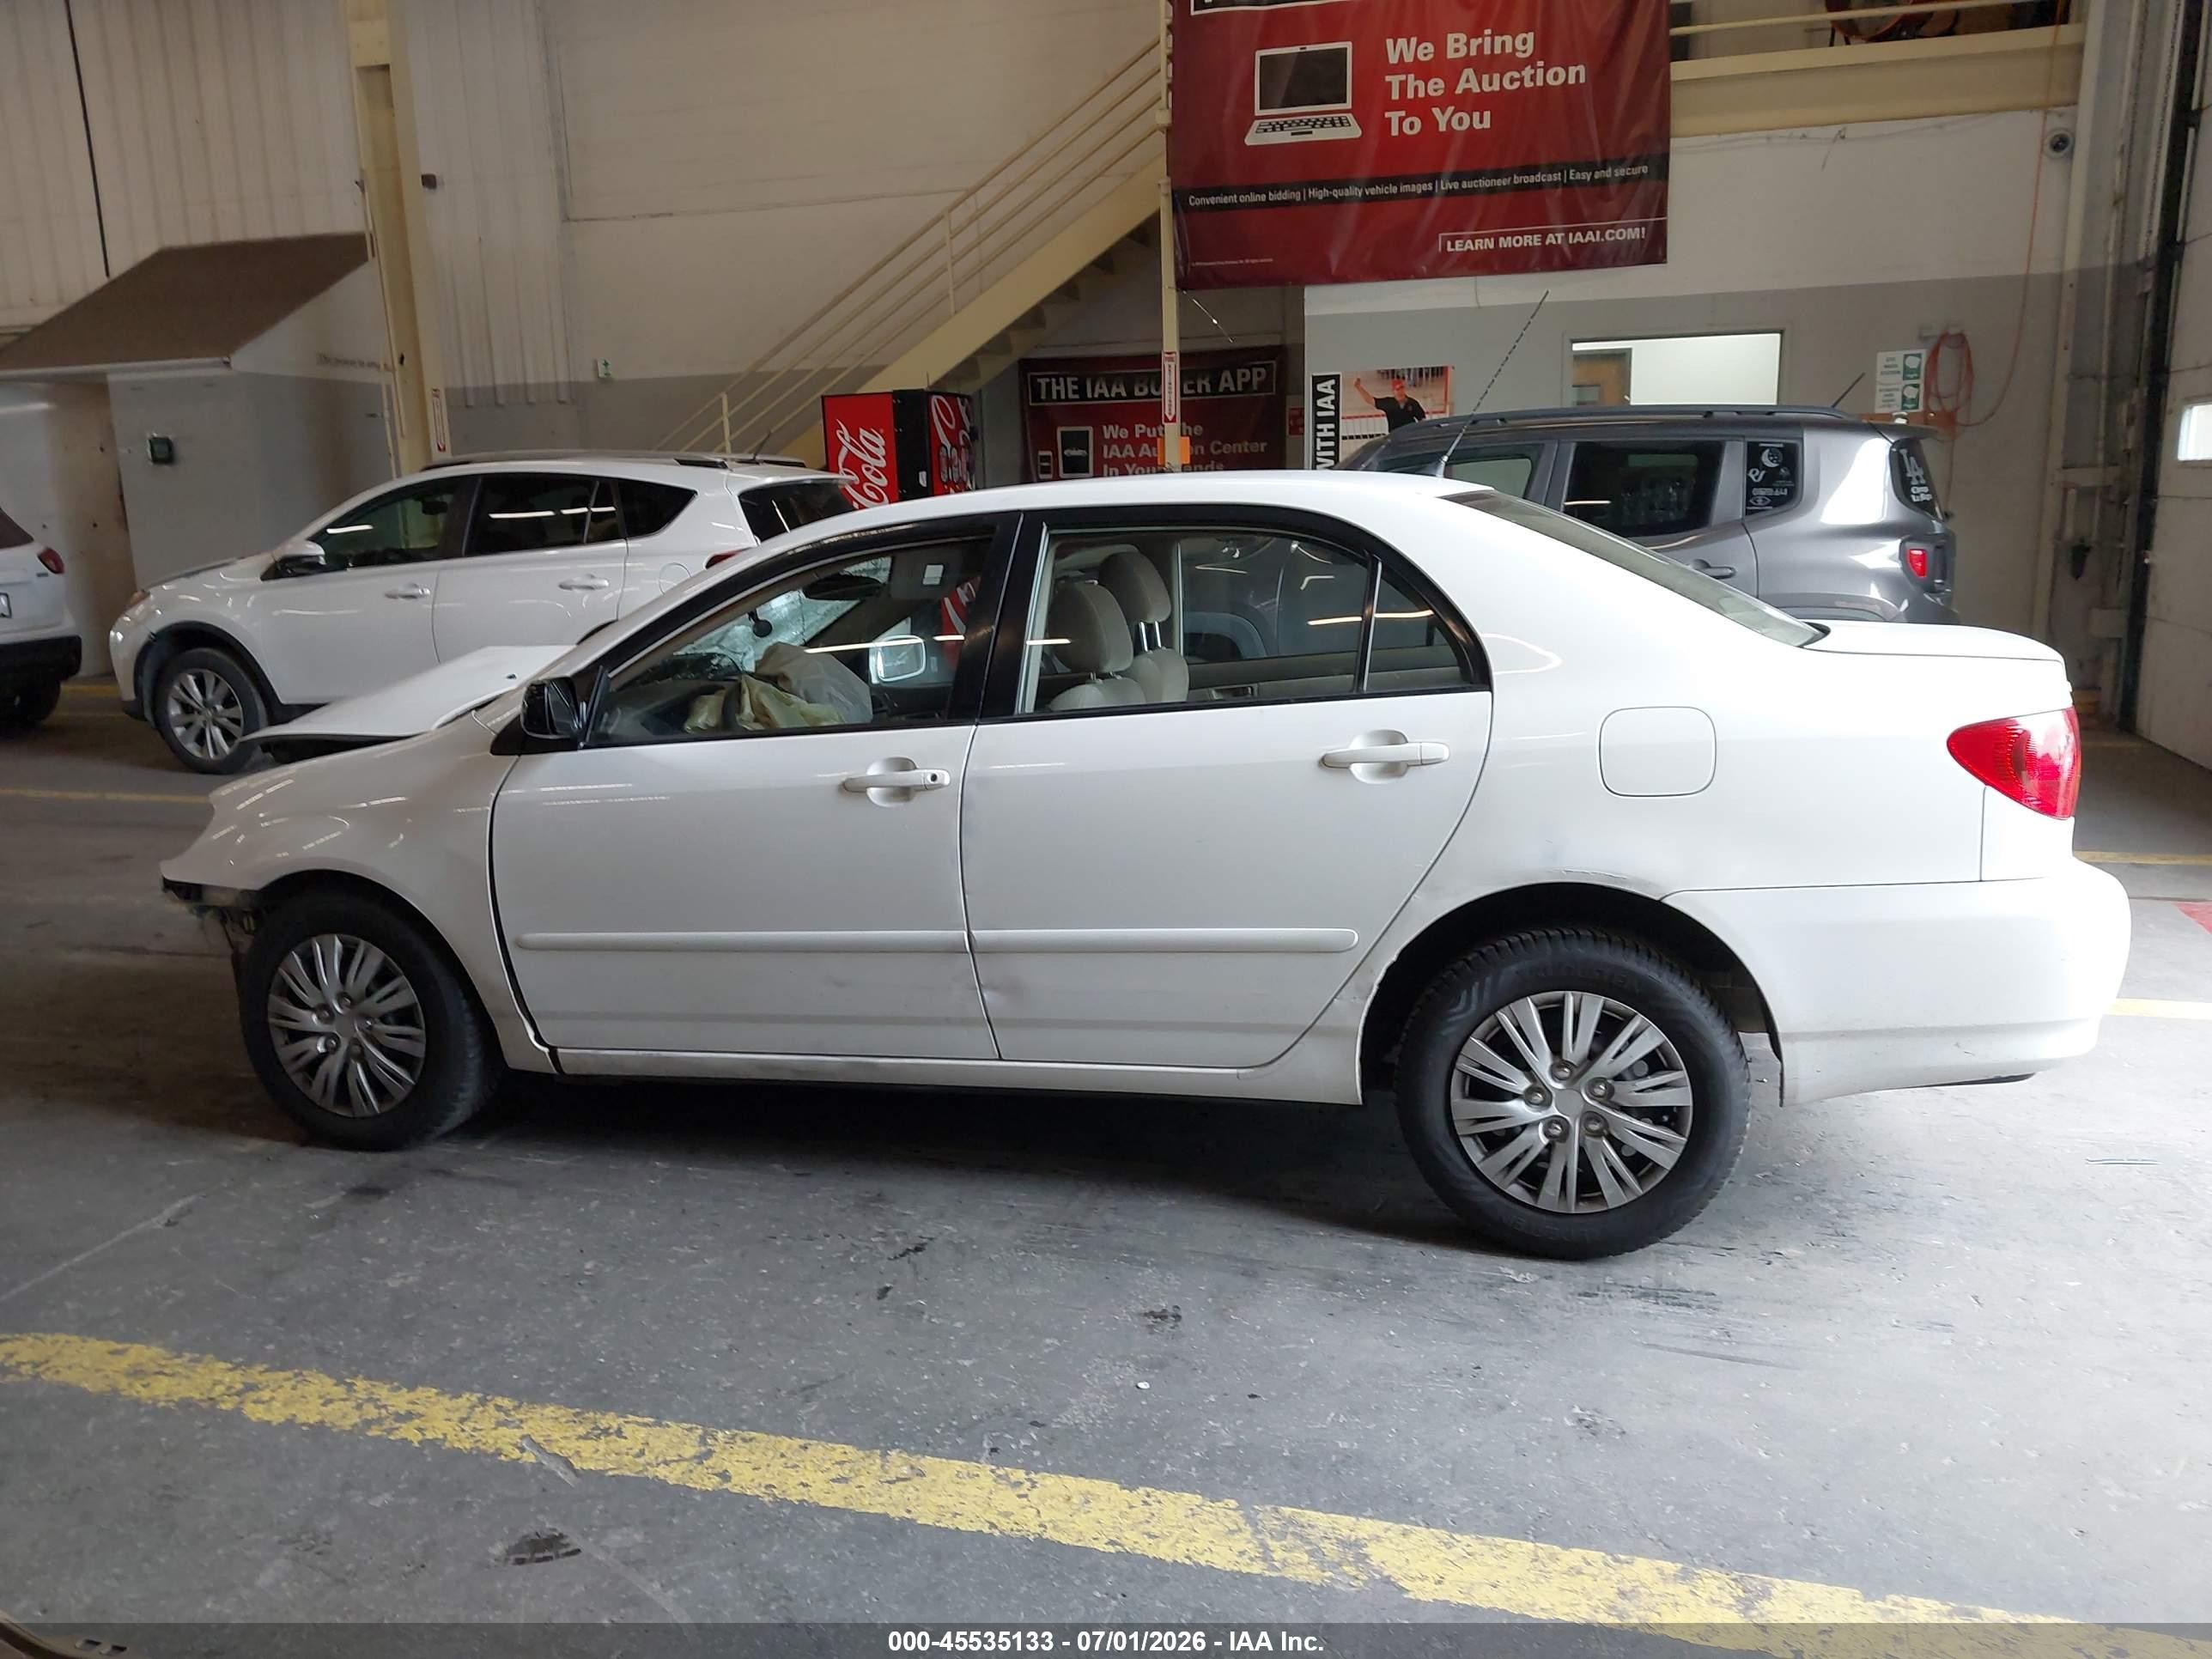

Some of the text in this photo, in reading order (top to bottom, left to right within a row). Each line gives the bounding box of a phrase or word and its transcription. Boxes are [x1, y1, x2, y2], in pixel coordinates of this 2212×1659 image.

[1385, 29, 1535, 64] We Bring
[1384, 61, 1587, 100] The Auction
[1384, 106, 1492, 137] To You
[1188, 194, 1237, 207] Convenient
[1239, 191, 1267, 204] online
[1268, 190, 1302, 203] bidding
[1308, 185, 1363, 199] High-quality
[1365, 183, 1398, 196] vehicle
[1400, 181, 1434, 194] images
[1440, 179, 1459, 191] Live
[1461, 177, 1511, 189] auctioneer
[1513, 172, 1562, 185] broadcast
[1569, 169, 1592, 183] Easy
[1594, 167, 1612, 179] and
[1613, 165, 1649, 177] secure
[1446, 227, 1646, 252] LEARN MORE AT IAAI.COM!
[1036, 377, 1080, 400] THE
[1085, 376, 1127, 398] IAA
[1133, 374, 1212, 397] BUER
[1218, 368, 1267, 392] APP
[1316, 379, 1336, 416] IAA
[1103, 422, 1203, 440] We Put he
[1103, 443, 1135, 459] IAA
[1210, 440, 1268, 455] Center
[1103, 465, 1120, 477] In
[1182, 460, 1225, 472] ands
